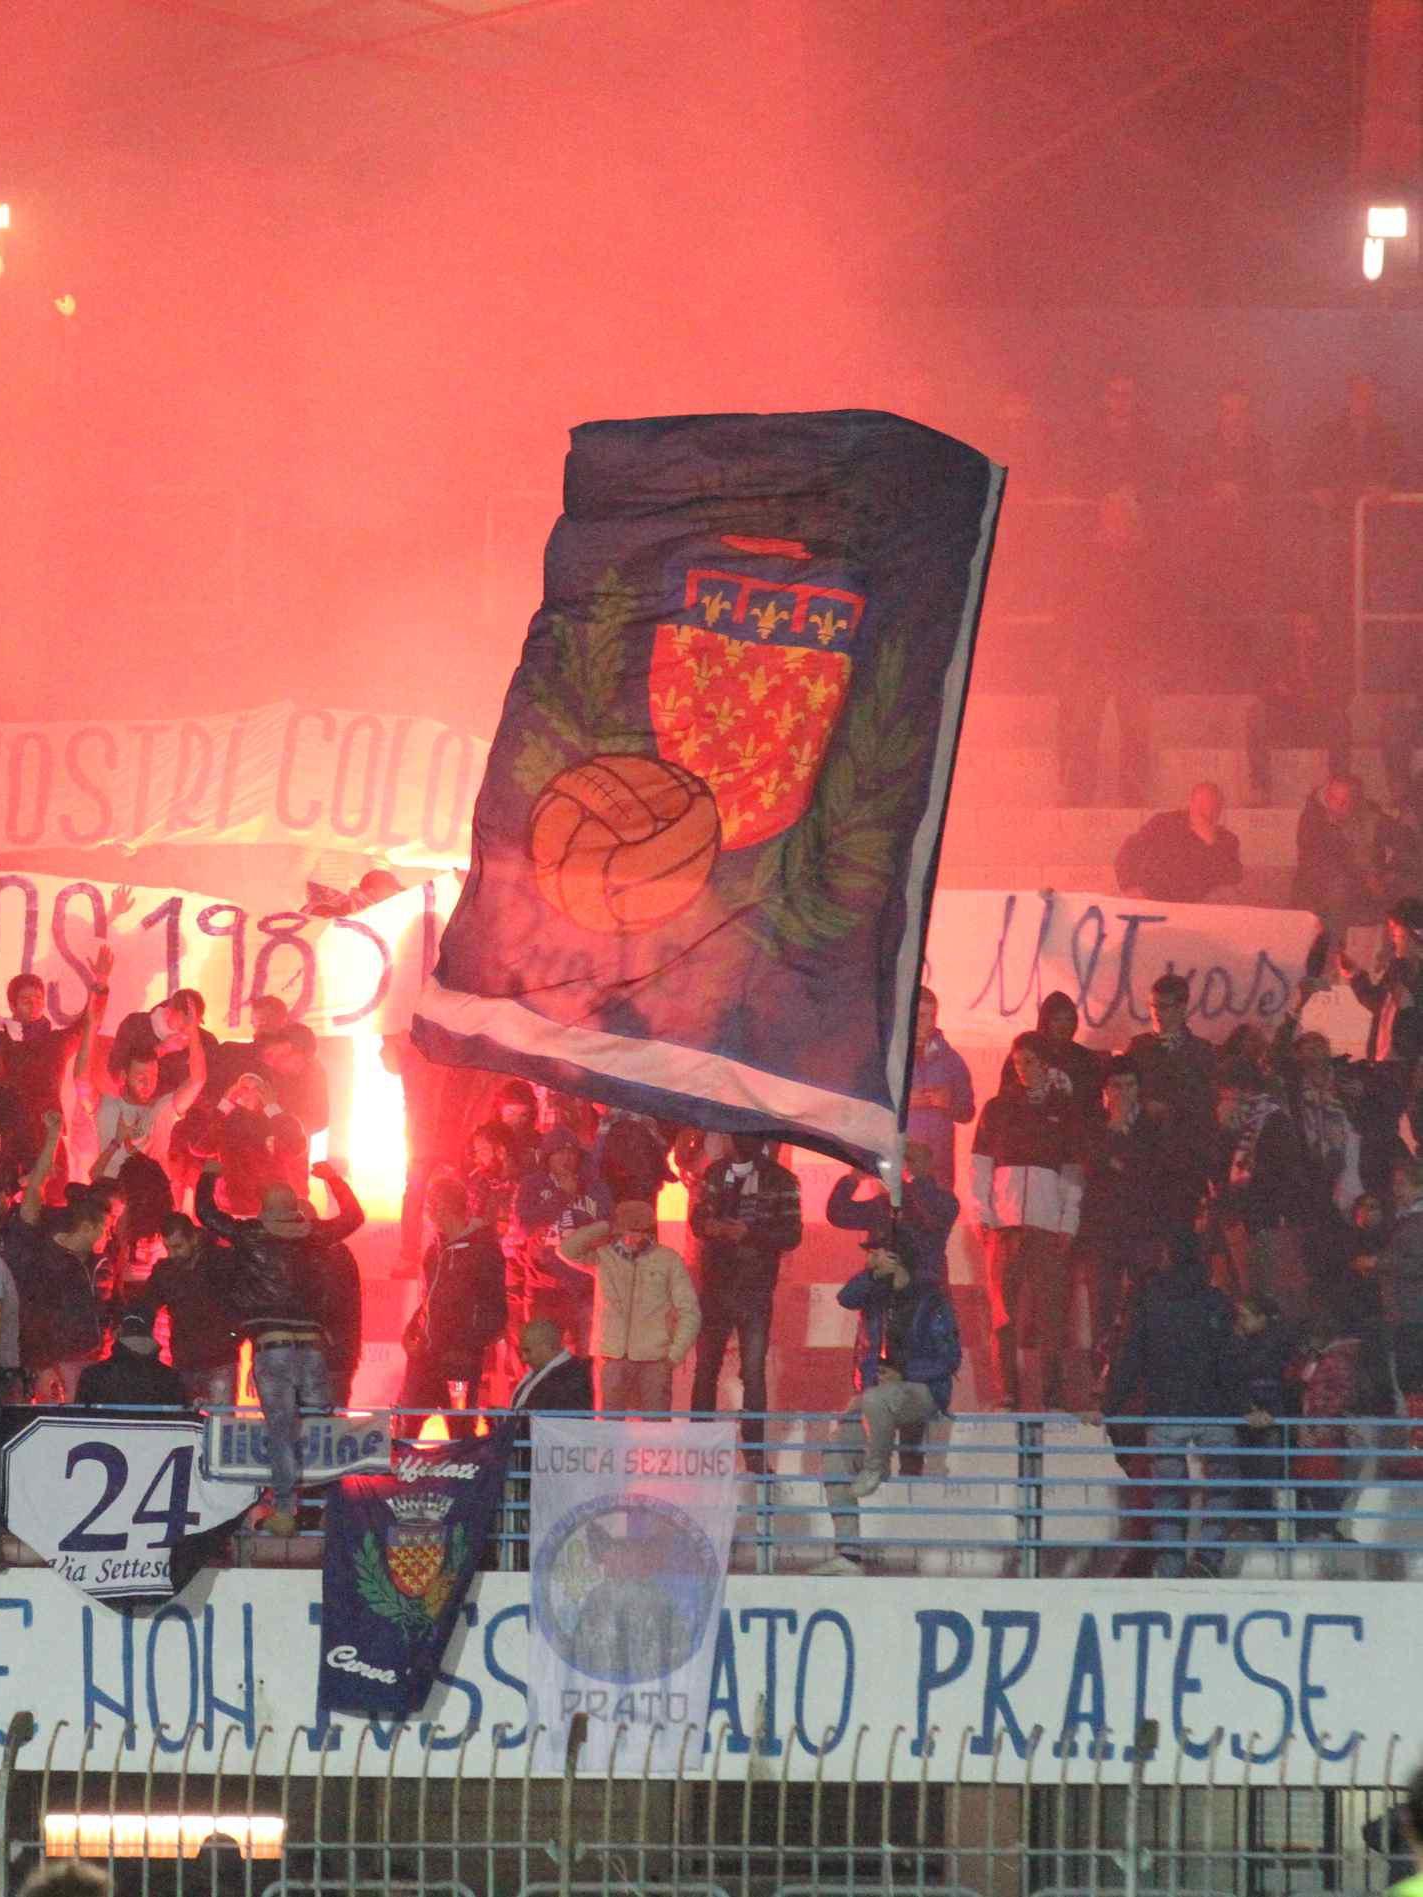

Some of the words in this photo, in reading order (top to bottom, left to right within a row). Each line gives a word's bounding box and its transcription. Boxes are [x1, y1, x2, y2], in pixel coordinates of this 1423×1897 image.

[58, 1441, 201, 1552] 24
[534, 1446, 615, 1474] LOSCA
[624, 1446, 732, 1477] SEZIONE
[561, 1689, 689, 1724] PRATO
[910, 1609, 1364, 1764] PRATESE
